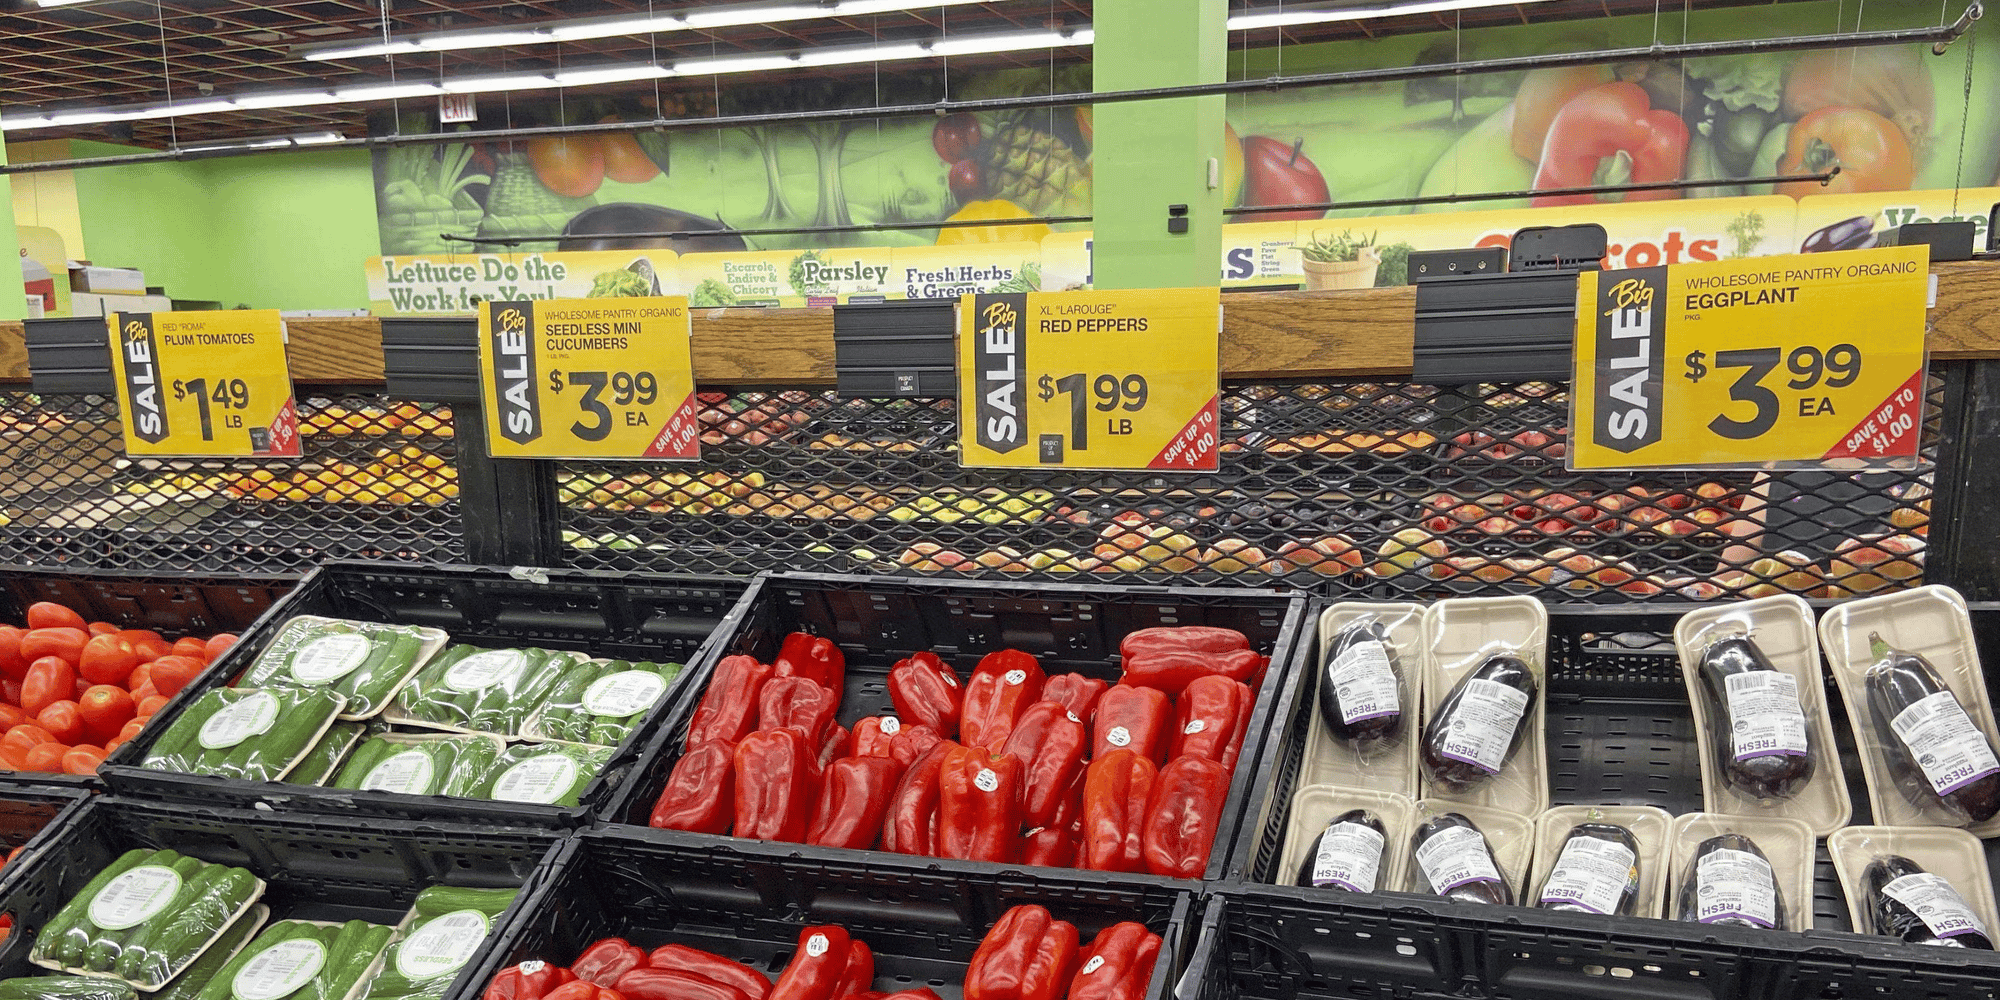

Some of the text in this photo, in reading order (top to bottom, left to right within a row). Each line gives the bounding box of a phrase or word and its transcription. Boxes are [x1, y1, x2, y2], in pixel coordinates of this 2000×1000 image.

[385, 257, 566, 284] Lettuce Do the
[723, 261, 777, 273] Escarole,
[727, 272, 777, 283] Endive &
[804, 260, 888, 285] Parsley
[906, 265, 1012, 283] Fresh Herbs
[1686, 261, 1917, 290] WHOLESOME PANTRY ORGANIC
[389, 287, 455, 311] Work
[732, 284, 778, 296] Chicory
[906, 283, 985, 298] & Greens
[1604, 278, 1654, 317] Big
[1685, 287, 1800, 311] EGGPLANT
[545, 308, 682, 320] WHOLESOME PANTRY ORGANIC
[980, 302, 1017, 333] Big
[1040, 303, 1117, 315] XL "LAROUGE"
[125, 320, 148, 346] Big
[162, 323, 175, 331] RED
[496, 308, 527, 337] Big
[545, 322, 642, 336] SEEDLESS MINI
[1040, 318, 1148, 333] RED PEPPERS
[165, 333, 255, 345] PLUM TOMATOES
[546, 338, 628, 350] CUCUMBERS
[500, 330, 534, 436] SALE
[1608, 306, 1651, 440] SALE
[129, 340, 162, 435] SALE
[986, 326, 1018, 443] SALE
[1799, 397, 1836, 417] EA
[225, 415, 243, 428] LB
[274, 418, 282, 432] UP
[281, 408, 290, 421] TO
[626, 412, 649, 426] EA
[655, 405, 692, 453] SAVE UP TO
[1108, 419, 1133, 435] LB
[1846, 388, 1914, 452] SAVE UP TO
[673, 424, 695, 454] $1.00
[1164, 411, 1213, 464] SAVE UP TO
[1873, 413, 1913, 454] $1.00
[1185, 432, 1214, 466] $1.00
[1346, 703, 1377, 719] FRESH
[1446, 742, 1479, 759] FRESH
[1738, 738, 1777, 753] FRESH
[1935, 763, 1973, 788] FRESH
[1316, 869, 1351, 882] FRESH
[1437, 869, 1471, 892] FRESH
[1546, 889, 1583, 900] FRESH
[1702, 904, 1742, 917] FRESH
